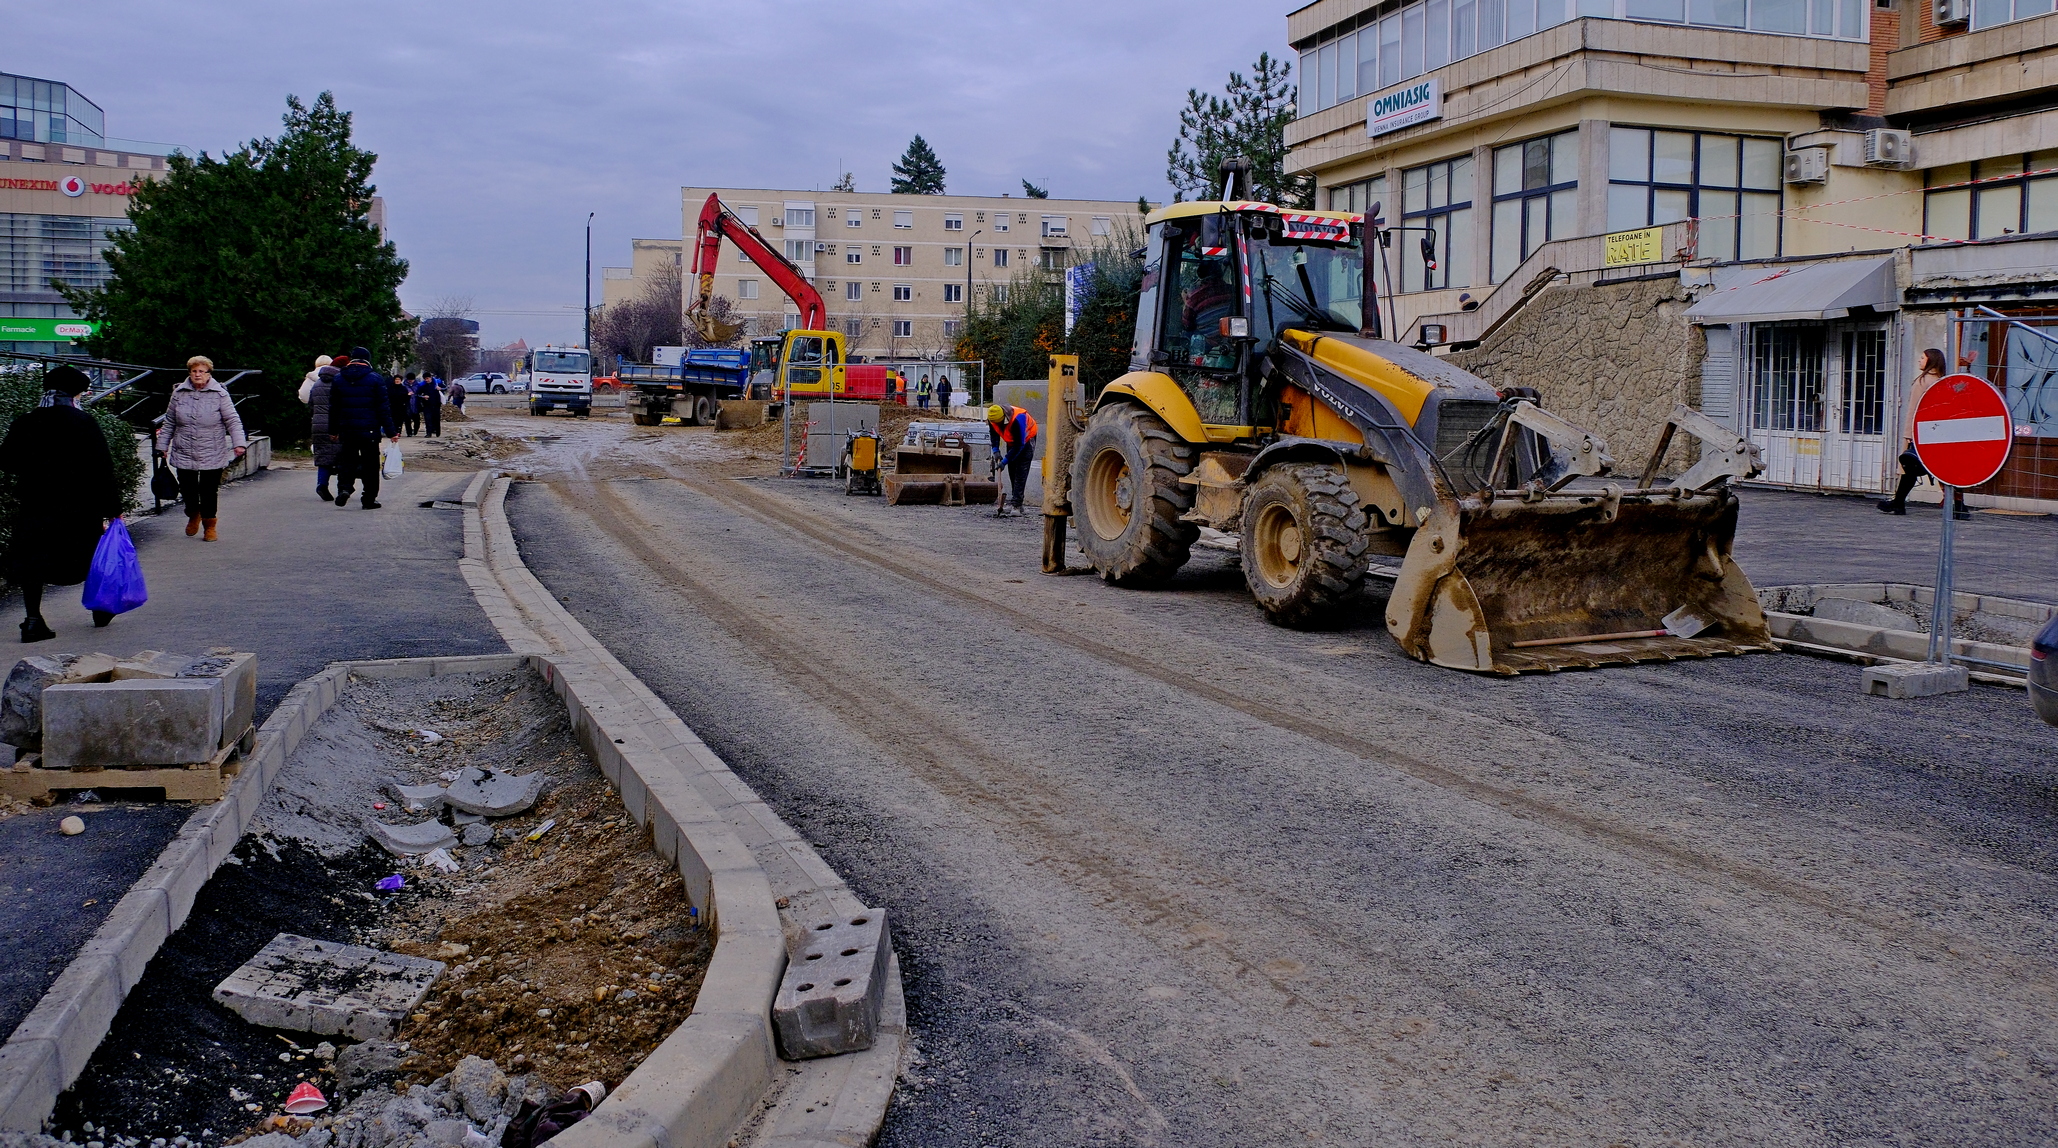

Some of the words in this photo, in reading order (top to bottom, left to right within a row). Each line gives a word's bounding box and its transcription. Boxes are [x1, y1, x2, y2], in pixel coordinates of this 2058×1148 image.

[1374, 83, 1430, 117] OMNIASIG
[1374, 123, 1389, 133] VIENNA
[1390, 115, 1413, 129] INSURANCE
[1414, 110, 1430, 121] GROUP
[1290, 222, 1339, 235] VOLVO
[1608, 233, 1642, 243] TELEFOANE
[1606, 242, 1650, 264] RATE
[1, 325, 36, 333] Farmacie
[1314, 382, 1354, 417] VOLVO
